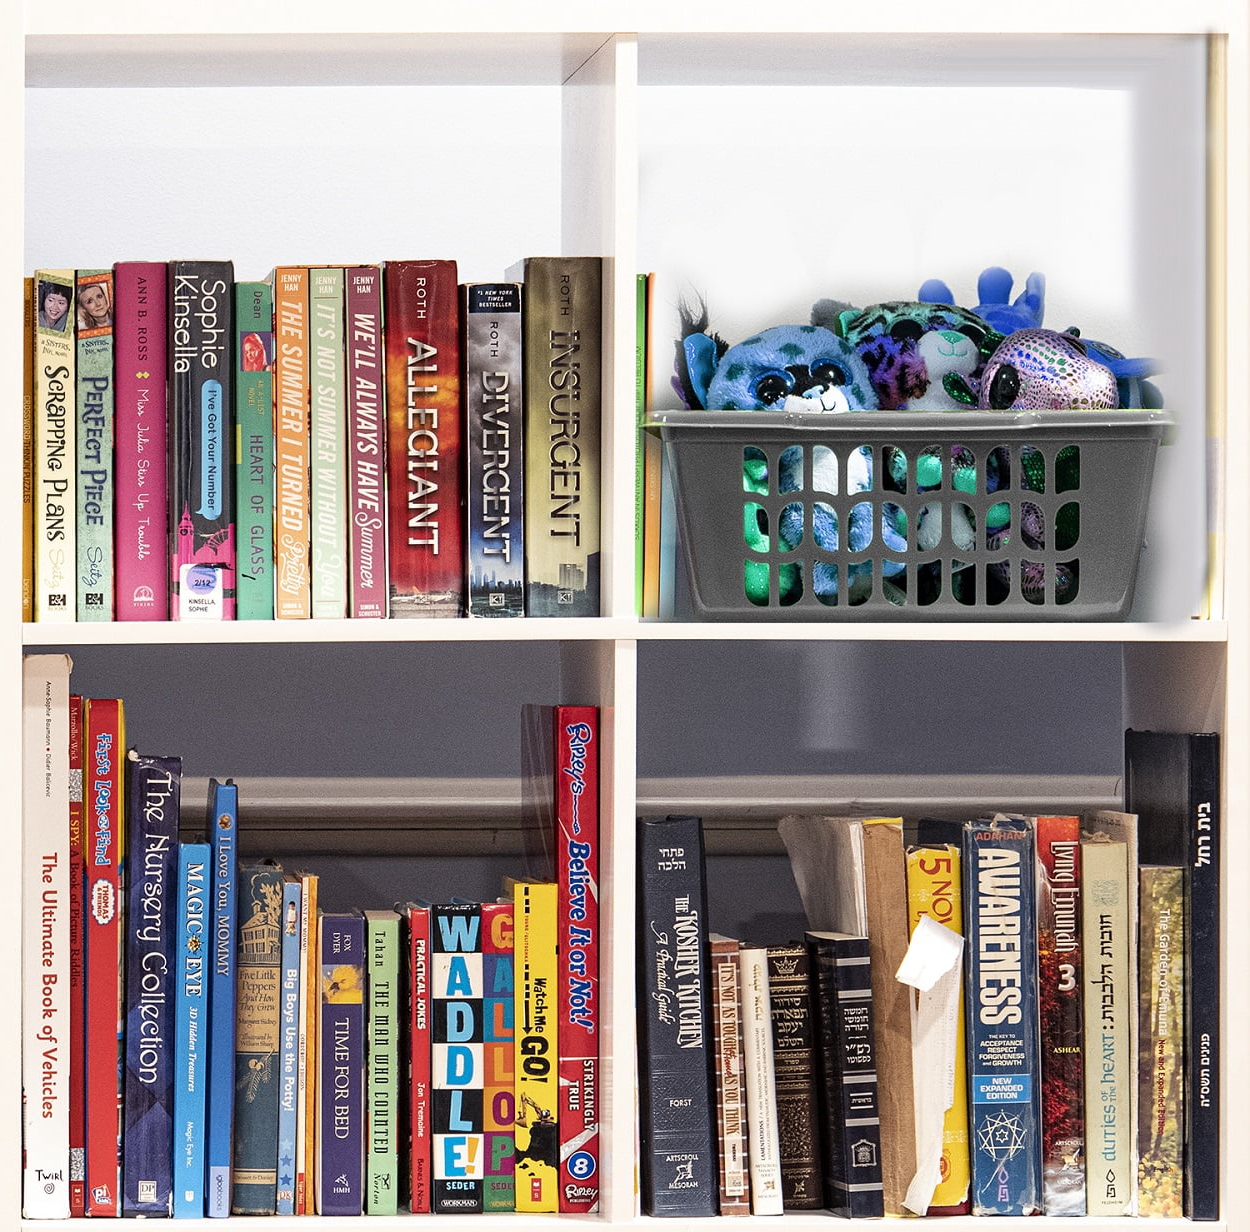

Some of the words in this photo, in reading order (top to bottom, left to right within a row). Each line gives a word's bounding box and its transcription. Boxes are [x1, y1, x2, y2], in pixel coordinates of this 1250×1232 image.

[138, 277, 146, 303] ANN
[253, 291, 263, 318] Dean
[417, 278, 426, 319] ROTH
[560, 275, 570, 316] ROTH
[138, 310, 147, 323] B.
[174, 275, 198, 373] Kinsella
[193, 280, 226, 368] Sophie
[138, 328, 147, 360] ROSS
[354, 313, 376, 369] WE'LL
[490, 322, 498, 358] ROTH
[208, 414, 217, 432] Got
[356, 377, 377, 454] ALWAYS
[549, 330, 581, 546] INSURGENT
[208, 436, 218, 457] Your
[250, 435, 264, 484] HEART
[408, 337, 439, 555] ALLEGIANT
[482, 372, 510, 562] DIVERGENT
[207, 461, 217, 510] Number
[250, 495, 263, 514] OF
[357, 459, 379, 512] HAVE
[355, 512, 382, 589] Summer
[143, 772, 172, 824] The
[41, 852, 57, 885] The
[218, 845, 229, 878] Love
[568, 840, 590, 922] Believe
[136, 833, 170, 942] Nursery
[186, 863, 204, 934] MAGIC
[216, 882, 229, 911] You,
[675, 894, 690, 913] THE
[41, 890, 57, 967] Ultimate
[217, 915, 229, 976] MOMMY
[374, 931, 386, 967] Tahan
[569, 925, 591, 948] It
[673, 910, 700, 976] KOSHER
[978, 849, 1023, 1025] AWARENESS
[1098, 915, 1114, 958] חובות
[185, 957, 203, 998] EYE
[416, 939, 425, 994] PRACTICAL
[569, 951, 587, 974] or
[42, 973, 58, 1015] Book
[417, 998, 426, 1030] JOKES
[569, 978, 593, 1028] Not!
[676, 979, 702, 1049] KITCHEN
[1090, 964, 1114, 1023] הלבבות
[37, 1019, 58, 1041] of
[137, 951, 166, 1084] Collection
[334, 1017, 348, 1063] TIME
[520, 1035, 550, 1083] GO!
[42, 1047, 59, 1119] Vehicles
[334, 1067, 349, 1101] FOR
[568, 1080, 580, 1111] TRUE
[582, 1060, 594, 1131] STRIKINGLY
[669, 1099, 692, 1107] FORST
[335, 1106, 349, 1139] BED
[445, 1181, 475, 1191] SEDER
